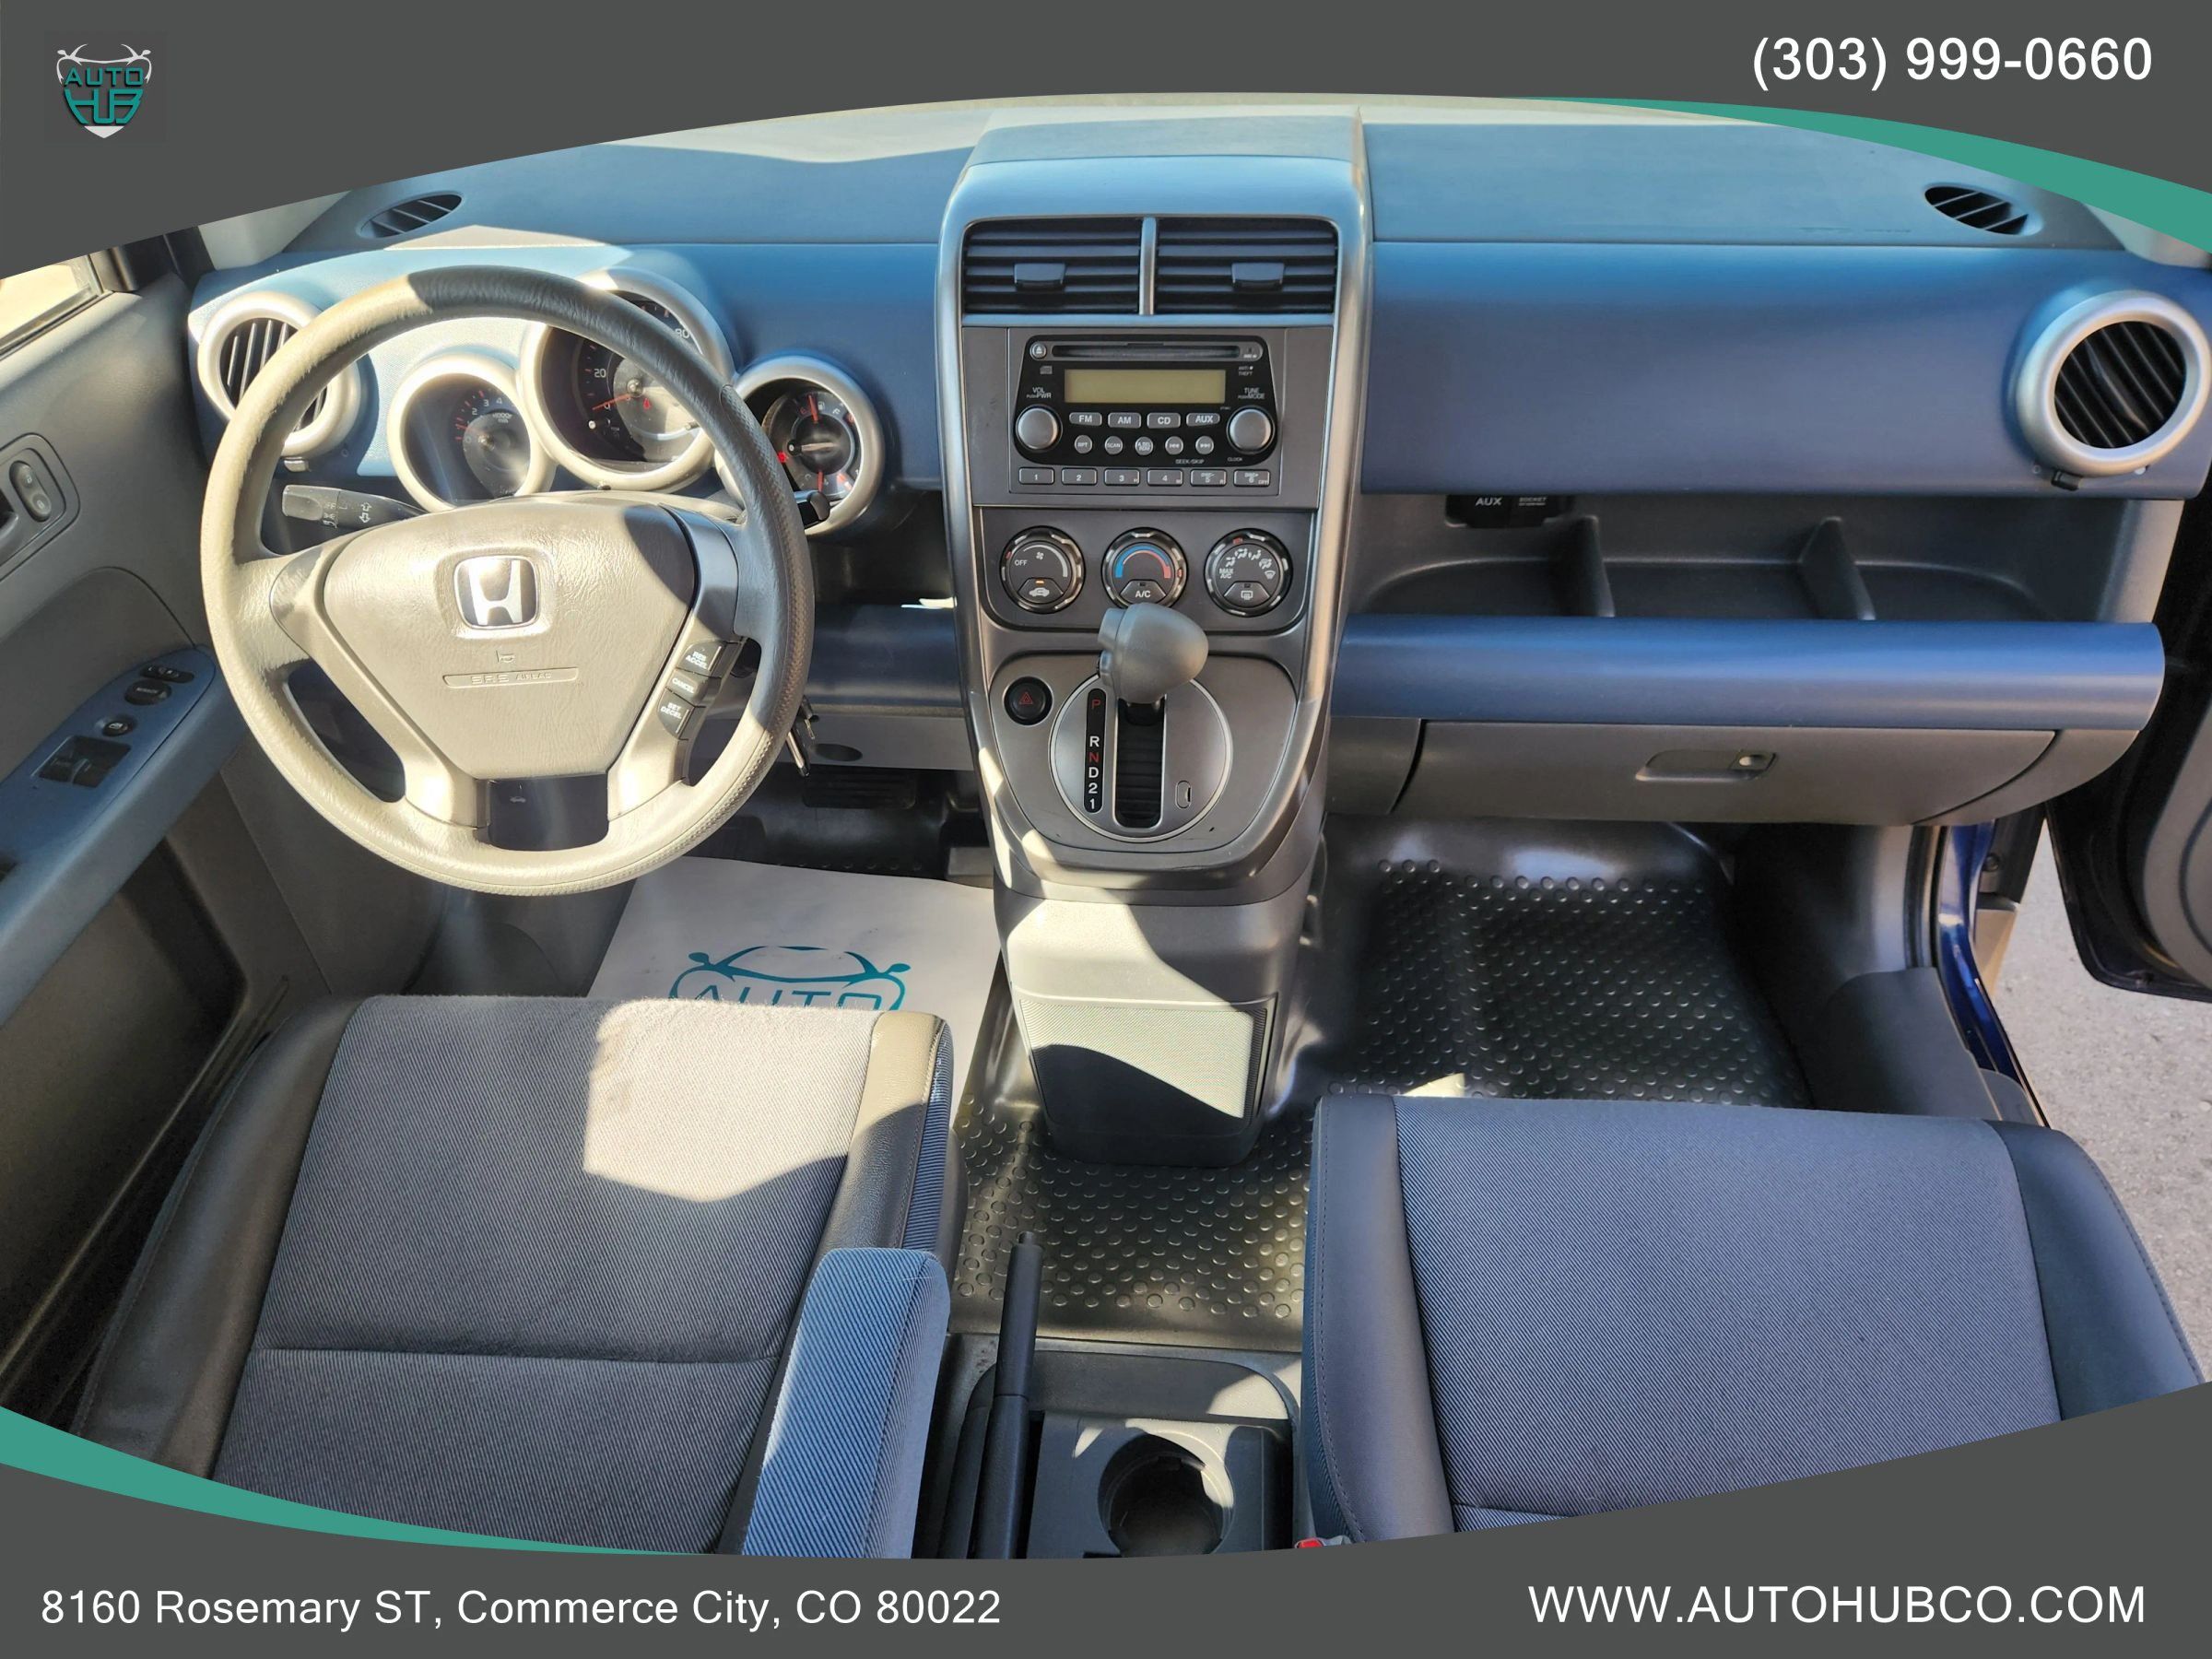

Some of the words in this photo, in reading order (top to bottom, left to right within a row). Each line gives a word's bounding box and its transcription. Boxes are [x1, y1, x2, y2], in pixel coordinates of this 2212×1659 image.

[594, 369, 606, 378] 20
[1078, 415, 1093, 423] FM
[1157, 417, 1171, 425] CD
[1195, 415, 1214, 423] AUX
[1475, 497, 1502, 506] AUX
[1135, 590, 1151, 598] A/C
[1091, 699, 1100, 709] P
[1089, 735, 1100, 747] R
[1088, 752, 1099, 762] N
[1088, 767, 1099, 778] D
[1088, 782, 1098, 794] 2
[1089, 798, 1095, 810] 1
